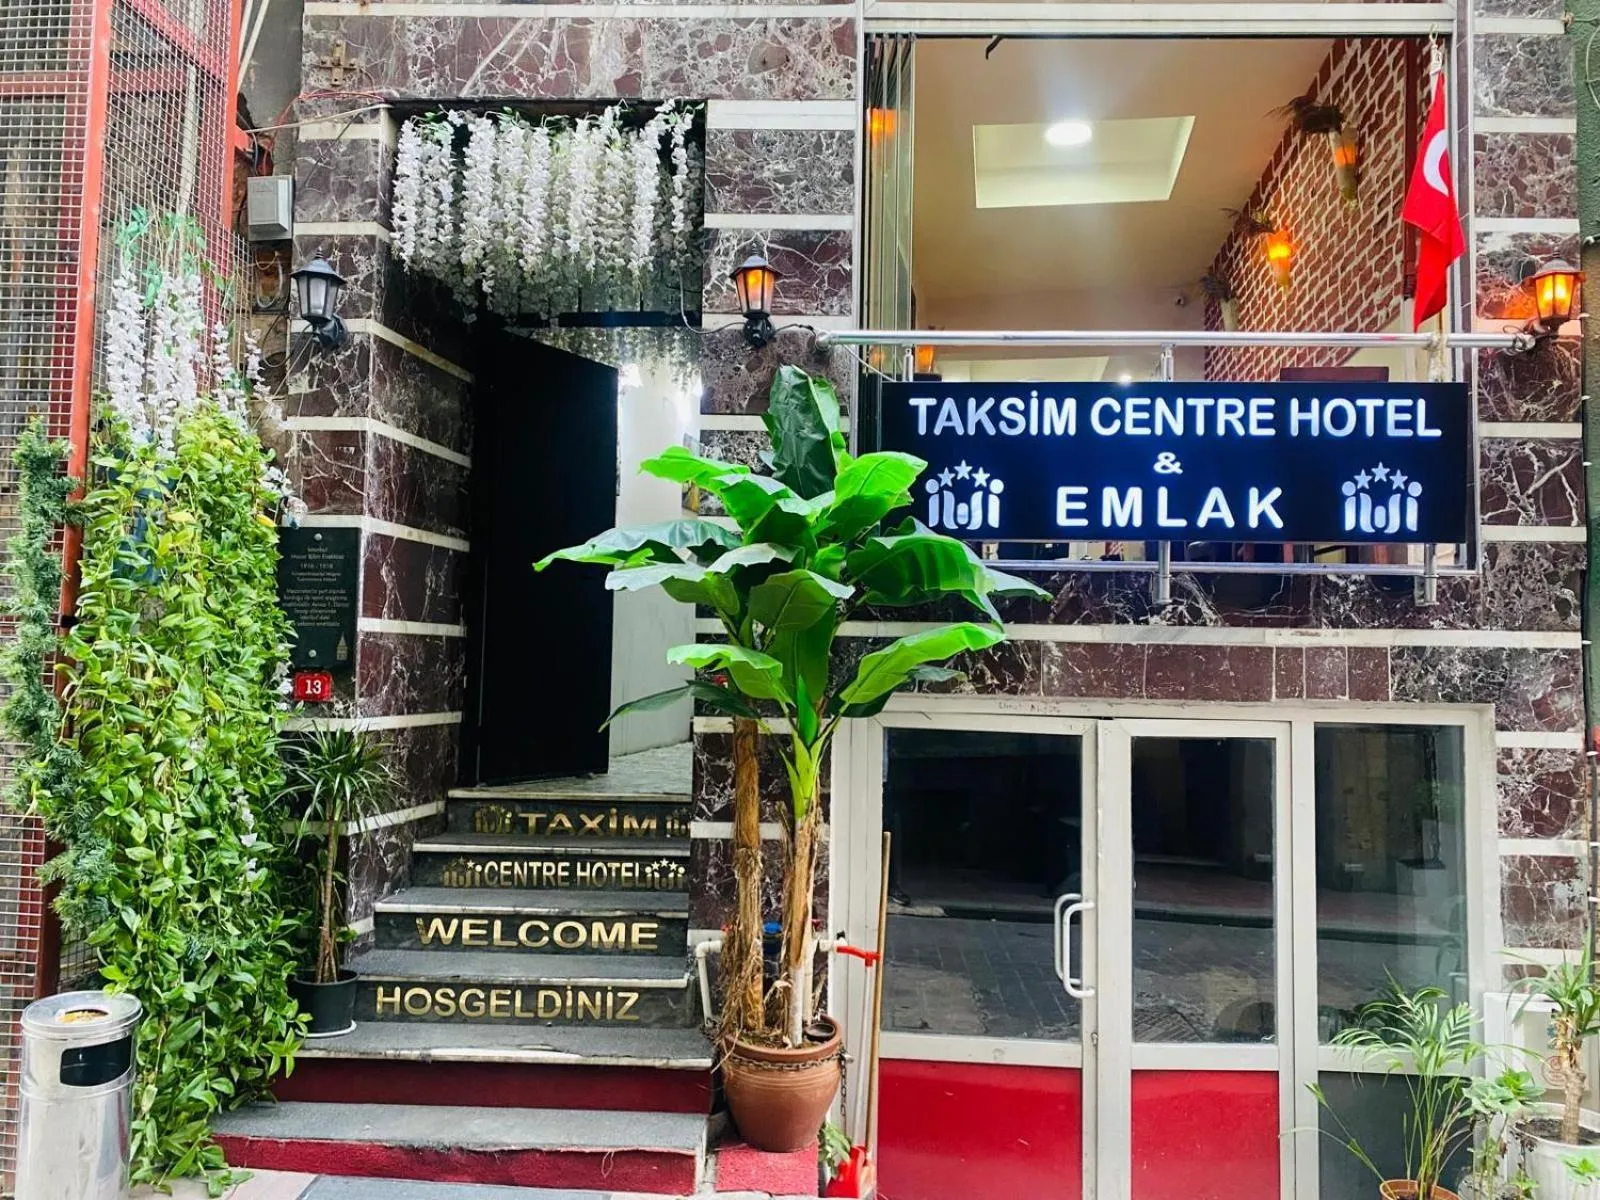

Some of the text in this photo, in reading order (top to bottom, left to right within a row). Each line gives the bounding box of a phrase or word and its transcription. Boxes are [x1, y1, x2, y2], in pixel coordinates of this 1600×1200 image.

[909, 390, 1442, 437] TAKSİM CENTRE HOTEL
[1153, 451, 1183, 475] &
[1056, 485, 1285, 529] EMLAK
[304, 679, 322, 695] 13
[518, 807, 657, 838] TAXİM
[483, 860, 646, 888] CENTRE HOTEL
[415, 917, 659, 950] WELCOME
[375, 984, 640, 1021] HOSGELDİNİZ
